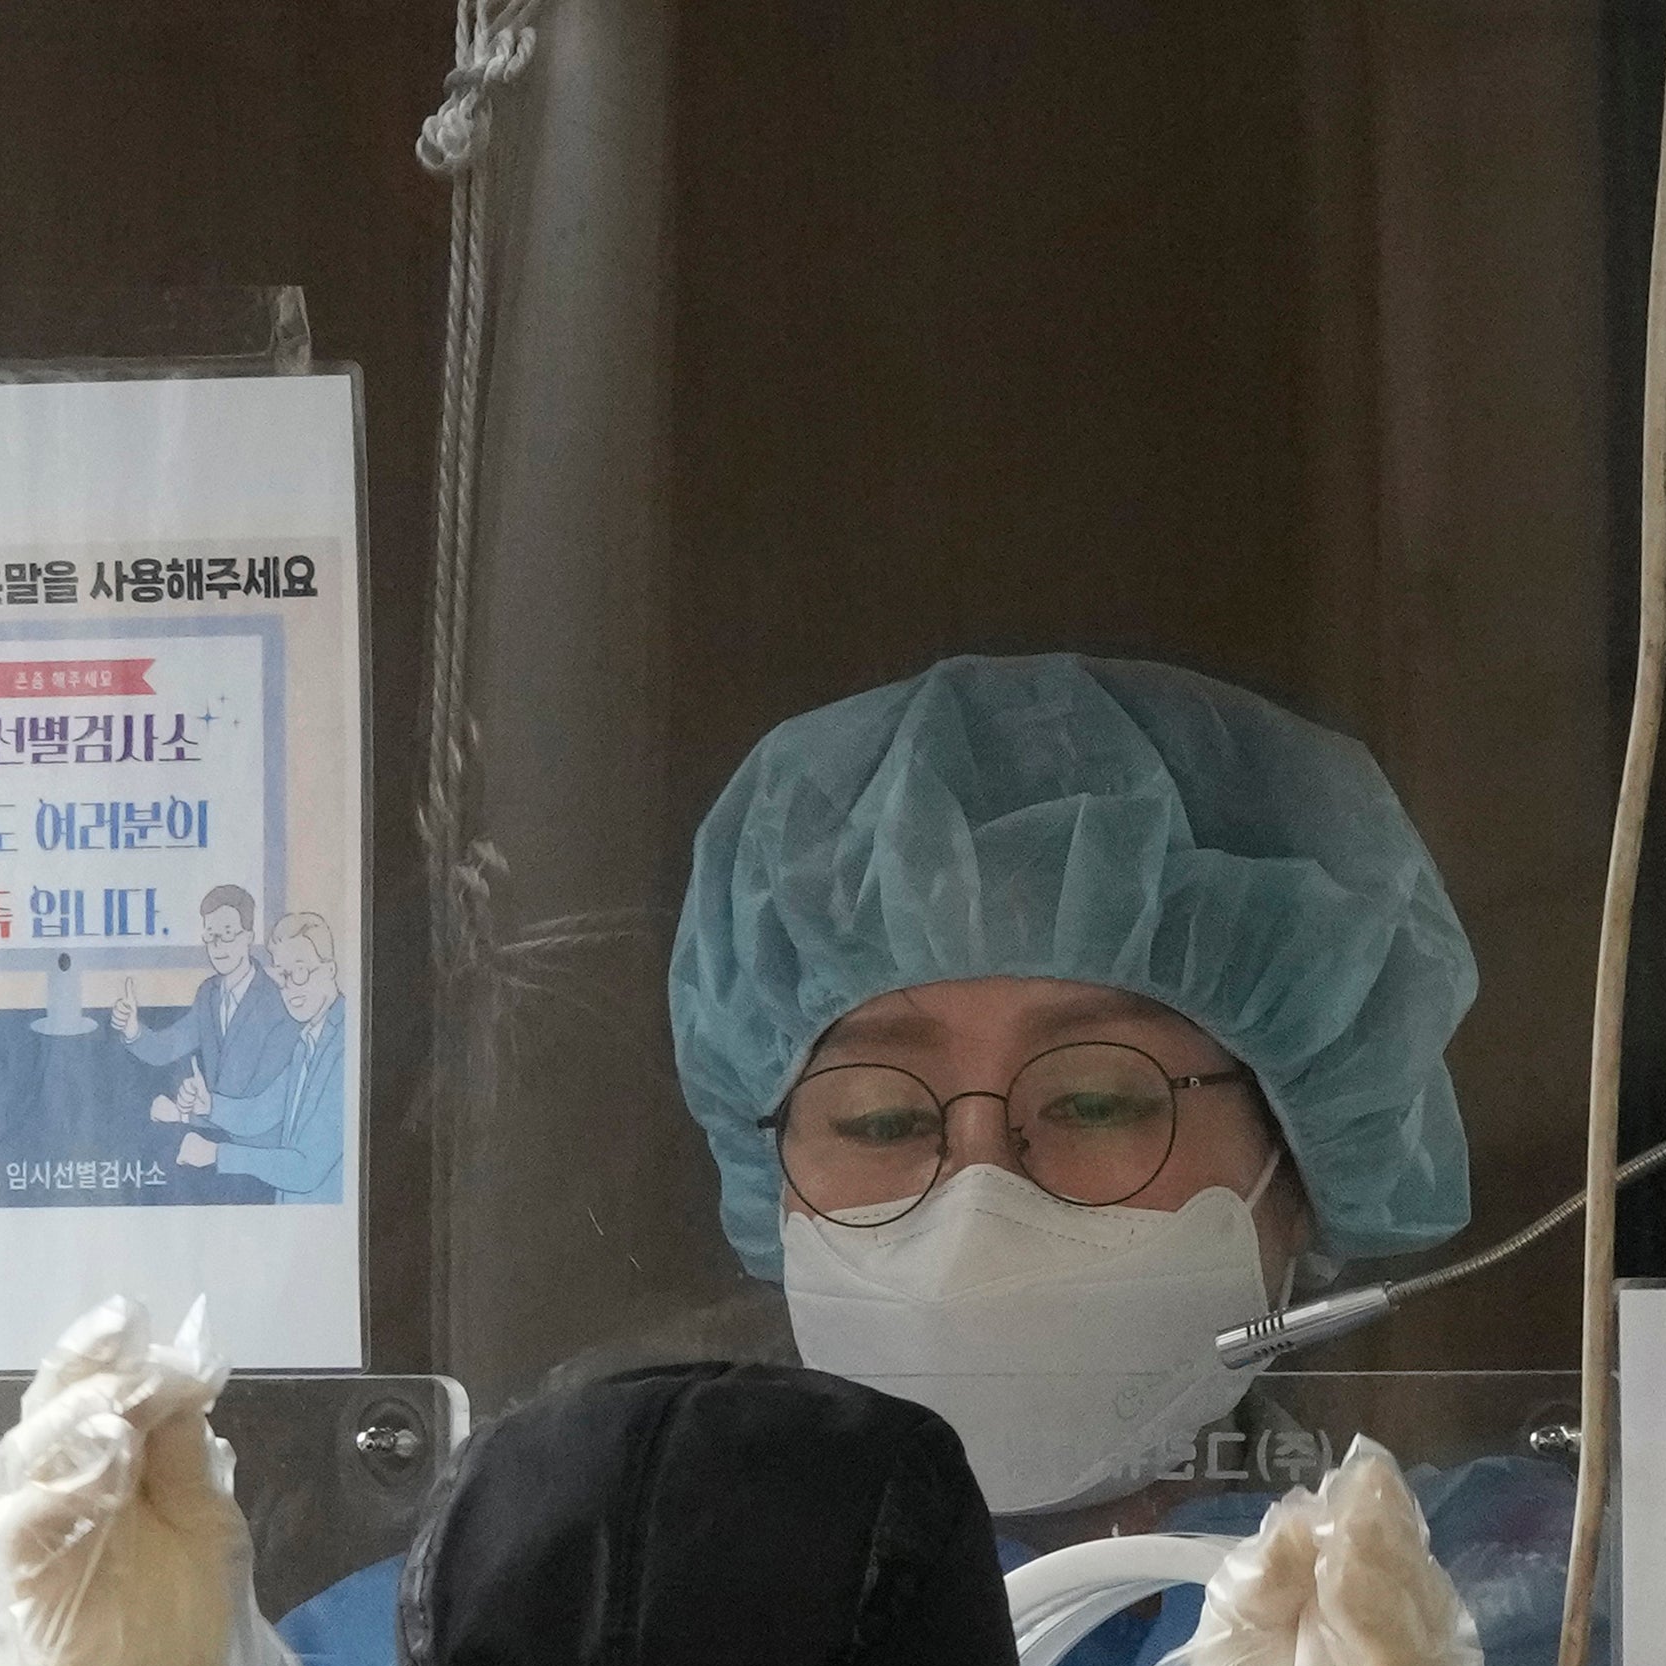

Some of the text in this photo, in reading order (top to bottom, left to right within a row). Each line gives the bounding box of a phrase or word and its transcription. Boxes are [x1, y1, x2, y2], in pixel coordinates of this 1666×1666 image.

[89, 555, 319, 603] 사용해주세요
[52, 669, 112, 689] 해주세요
[35, 795, 209, 852] 여러분의
[30, 886, 170, 940] 입니다.
[6, 1159, 168, 1190] 임시선별검사소
